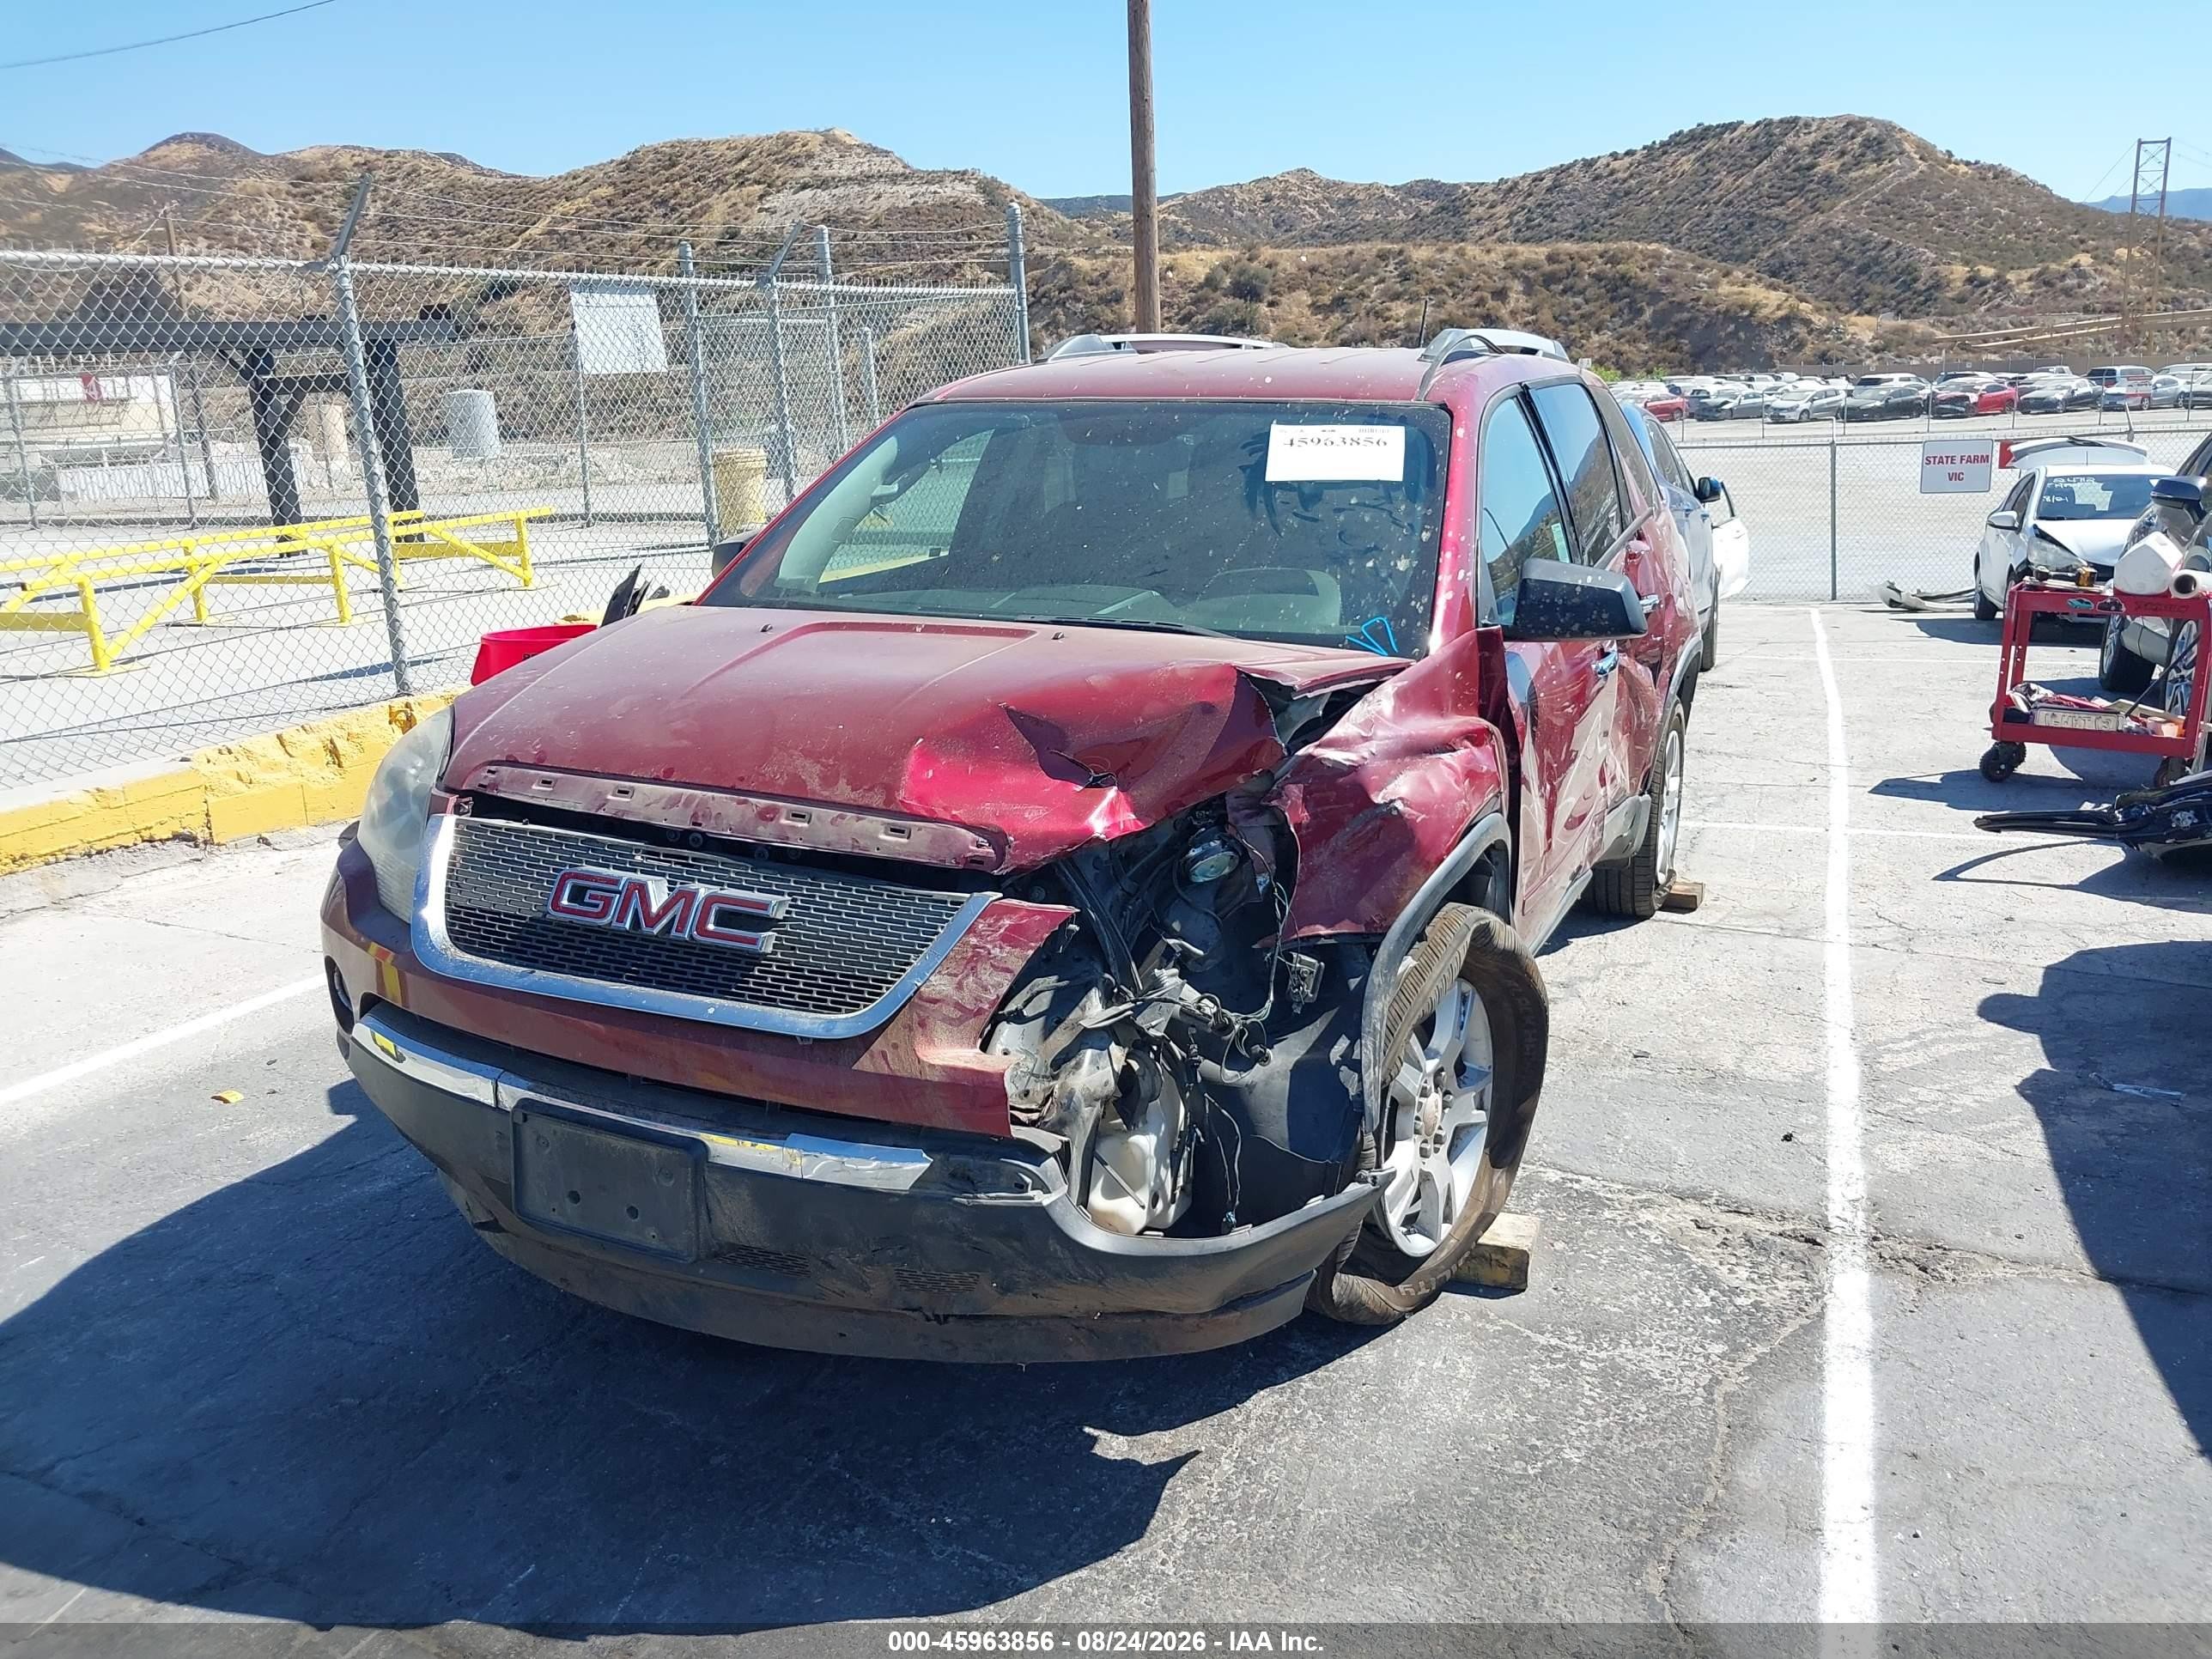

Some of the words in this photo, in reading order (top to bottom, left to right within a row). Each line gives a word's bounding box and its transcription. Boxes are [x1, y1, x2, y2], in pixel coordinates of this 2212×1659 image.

[1924, 455, 1957, 465] STATE
[1960, 454, 1990, 465] FARM
[1948, 471, 1964, 482] VIC
[548, 866, 792, 953] GMC
